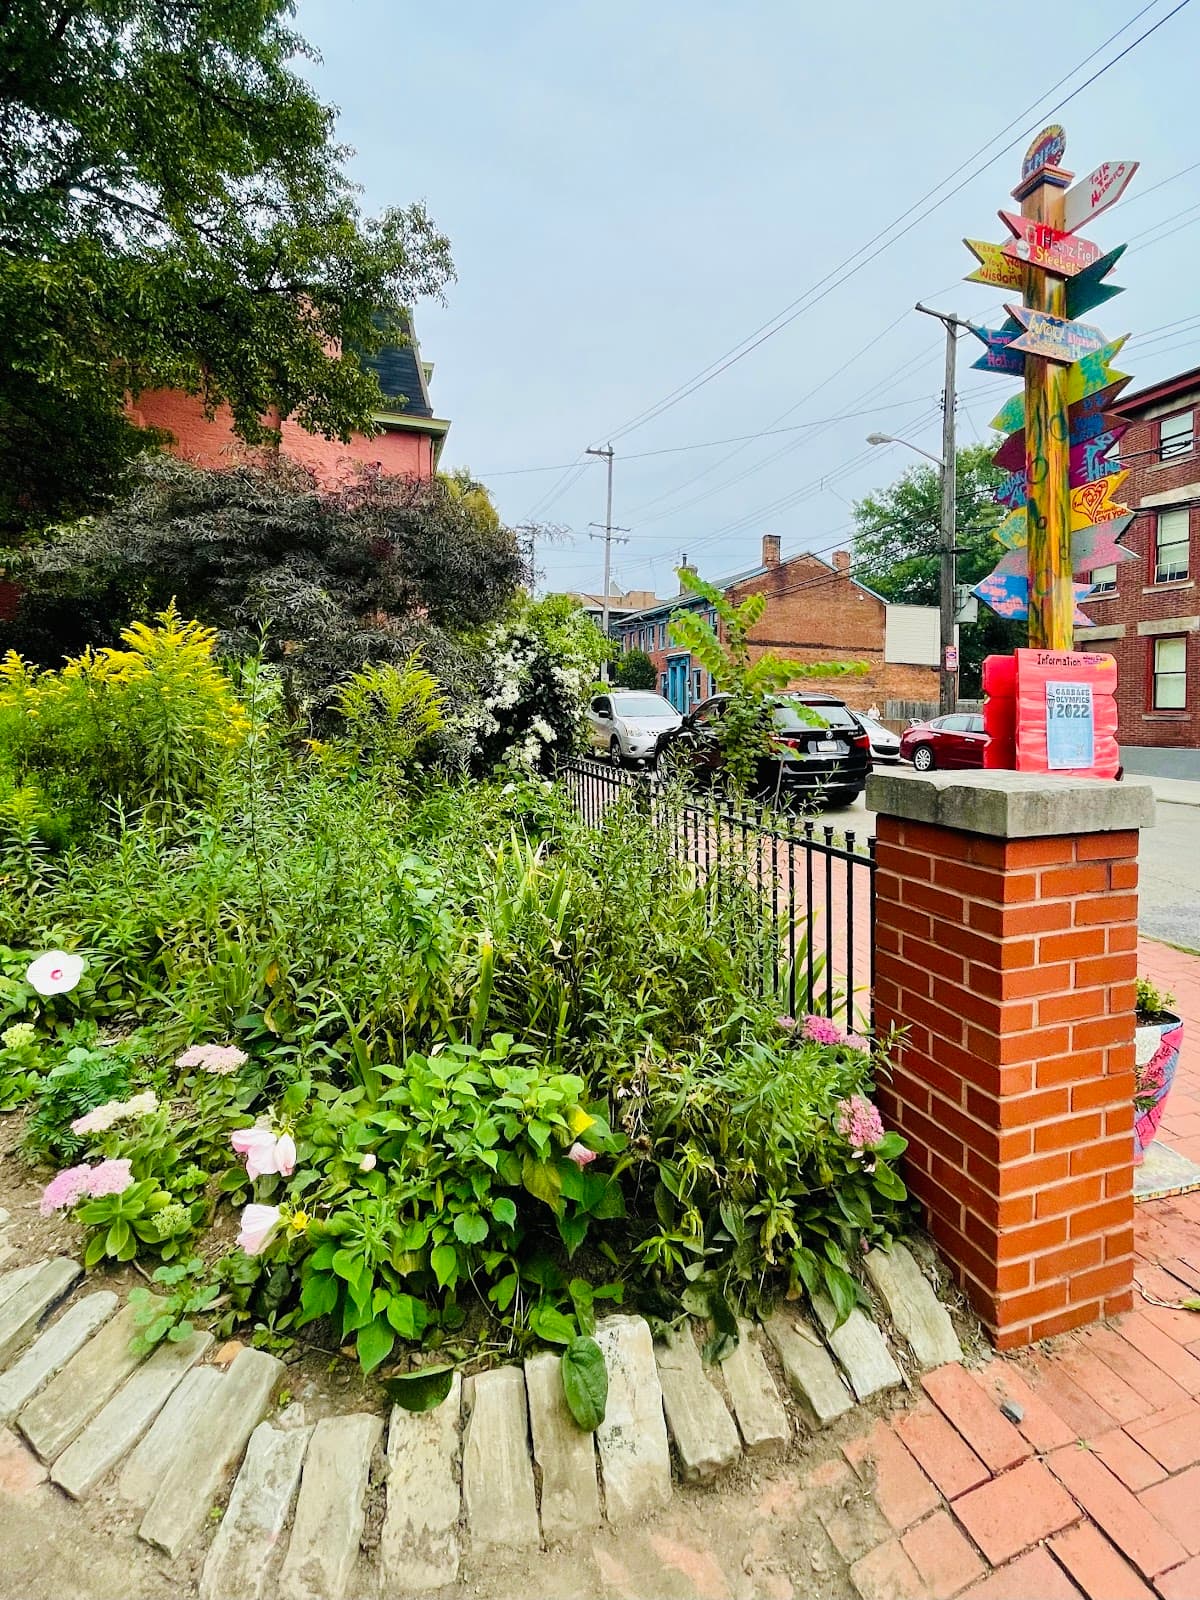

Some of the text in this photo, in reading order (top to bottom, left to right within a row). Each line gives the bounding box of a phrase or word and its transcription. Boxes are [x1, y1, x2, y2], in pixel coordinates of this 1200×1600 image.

[1037, 653, 1081, 666] Information
[1055, 688, 1090, 697] GARBAGE
[1056, 696, 1090, 704] OLYMPICS
[1056, 703, 1090, 719] 2022
